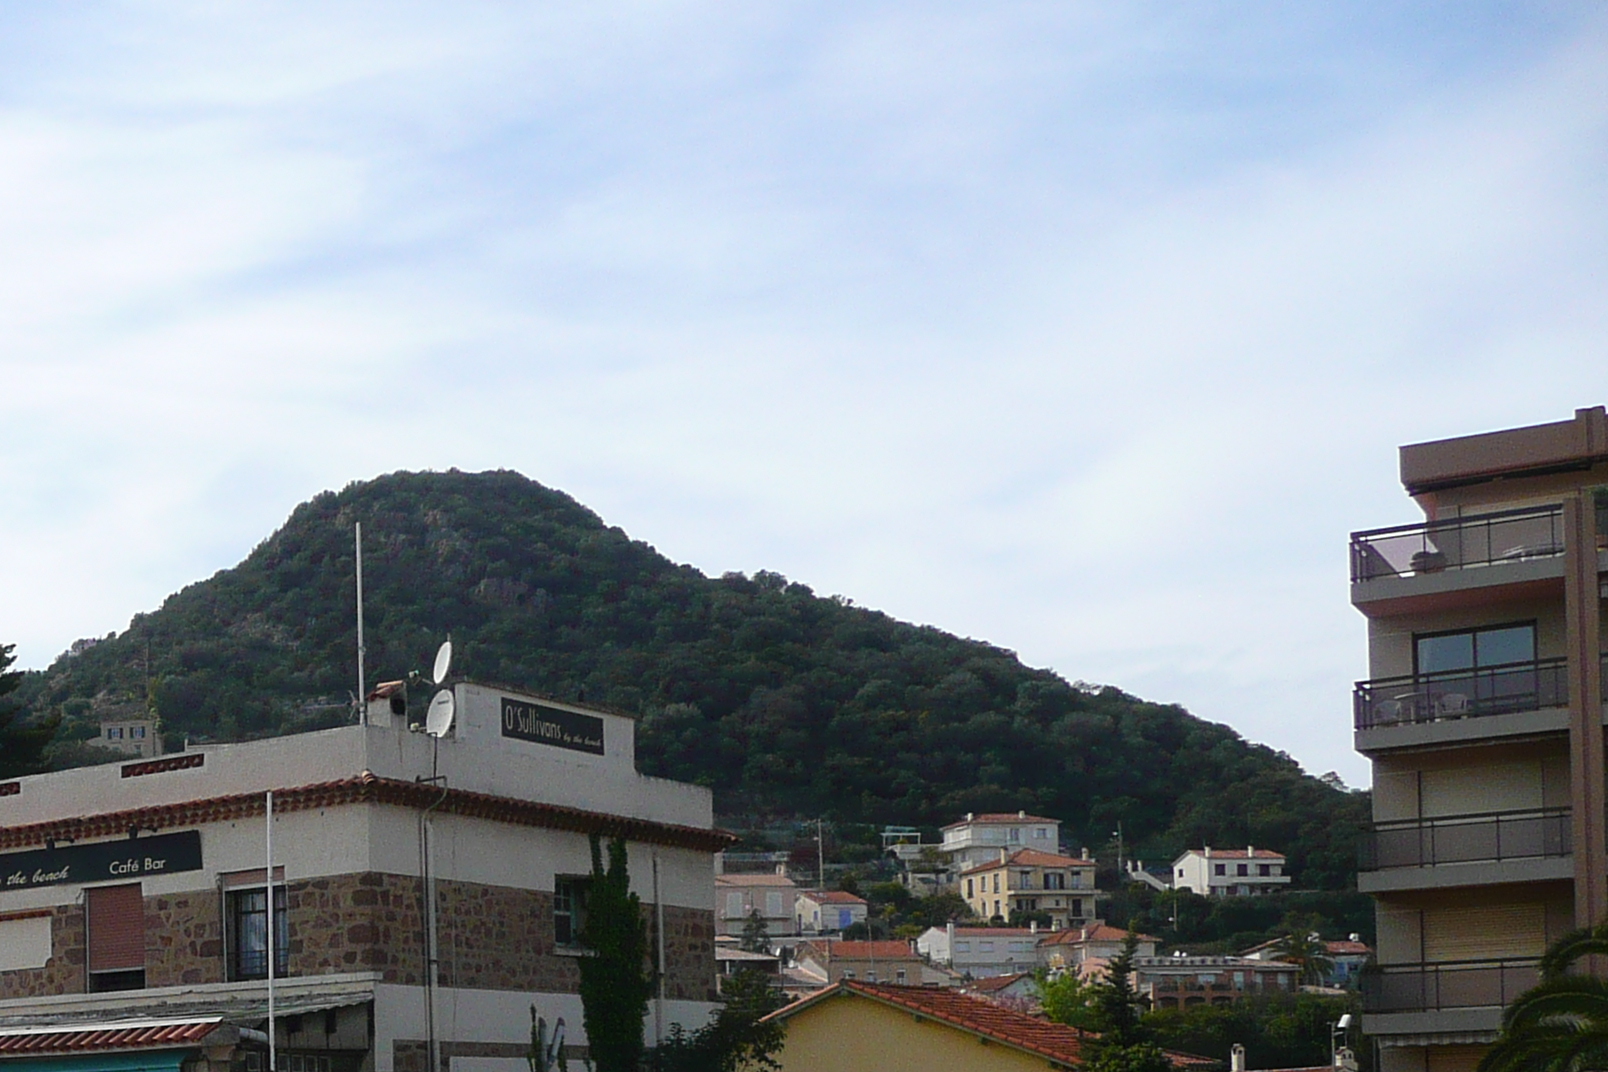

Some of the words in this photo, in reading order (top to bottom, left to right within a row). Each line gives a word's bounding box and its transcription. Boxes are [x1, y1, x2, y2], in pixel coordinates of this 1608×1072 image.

[505, 705, 562, 740] O'Sullivans
[6, 872, 27, 886] the
[32, 865, 70, 884] beach
[109, 859, 139, 874] Café
[144, 858, 166, 871] Bar
